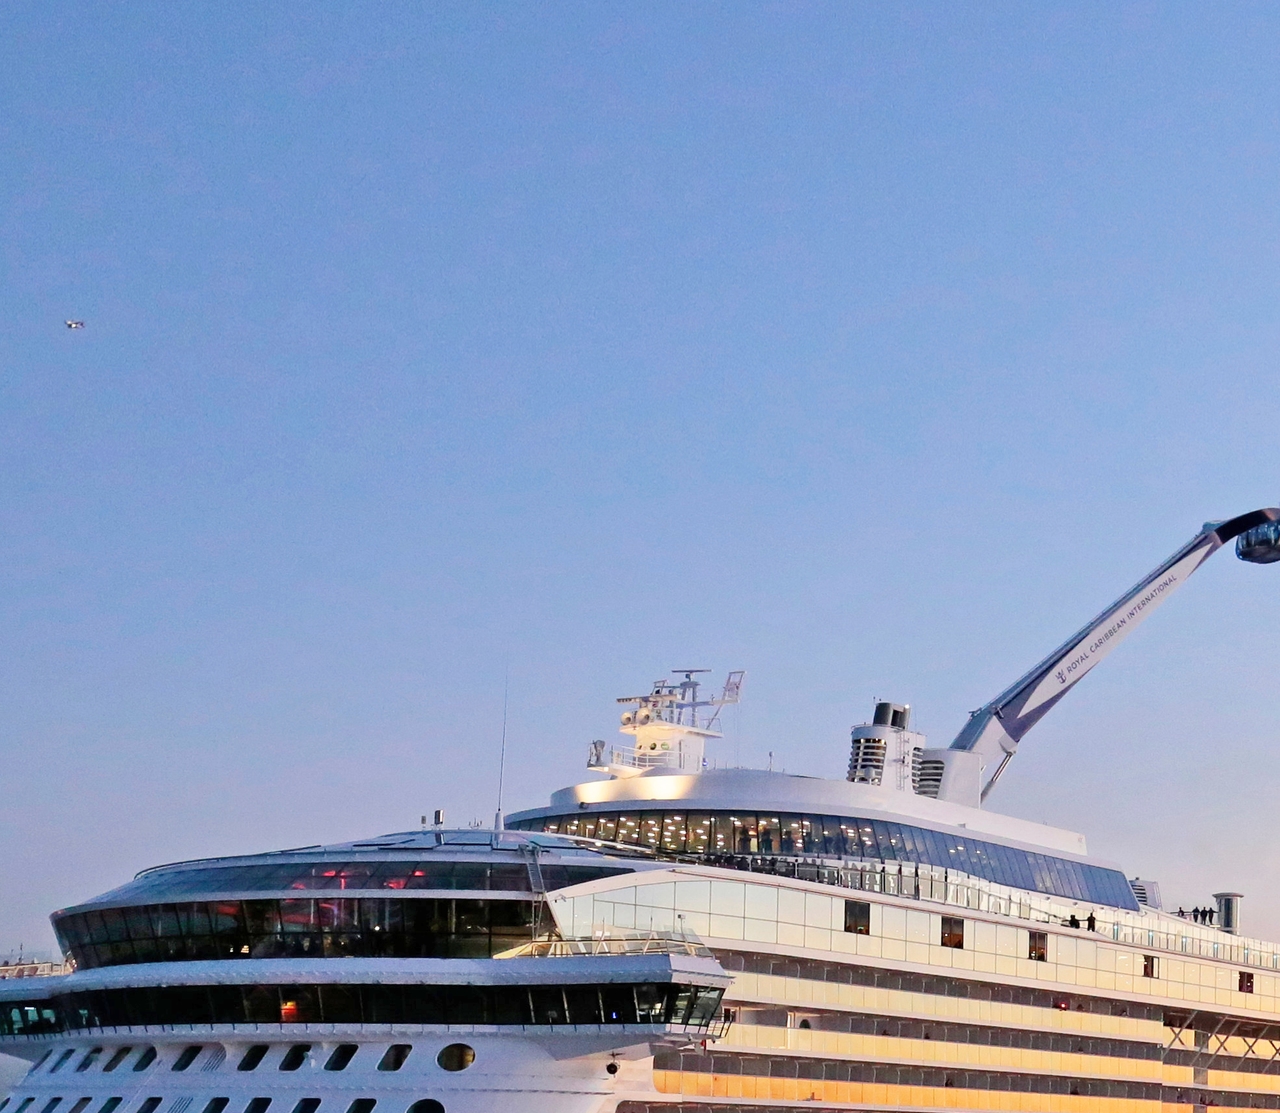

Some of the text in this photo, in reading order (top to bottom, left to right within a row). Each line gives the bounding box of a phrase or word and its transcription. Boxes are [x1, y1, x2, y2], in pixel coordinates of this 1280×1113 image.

[1066, 574, 1178, 674] ROYAL CARIBBEAN INTERNATIONAL
